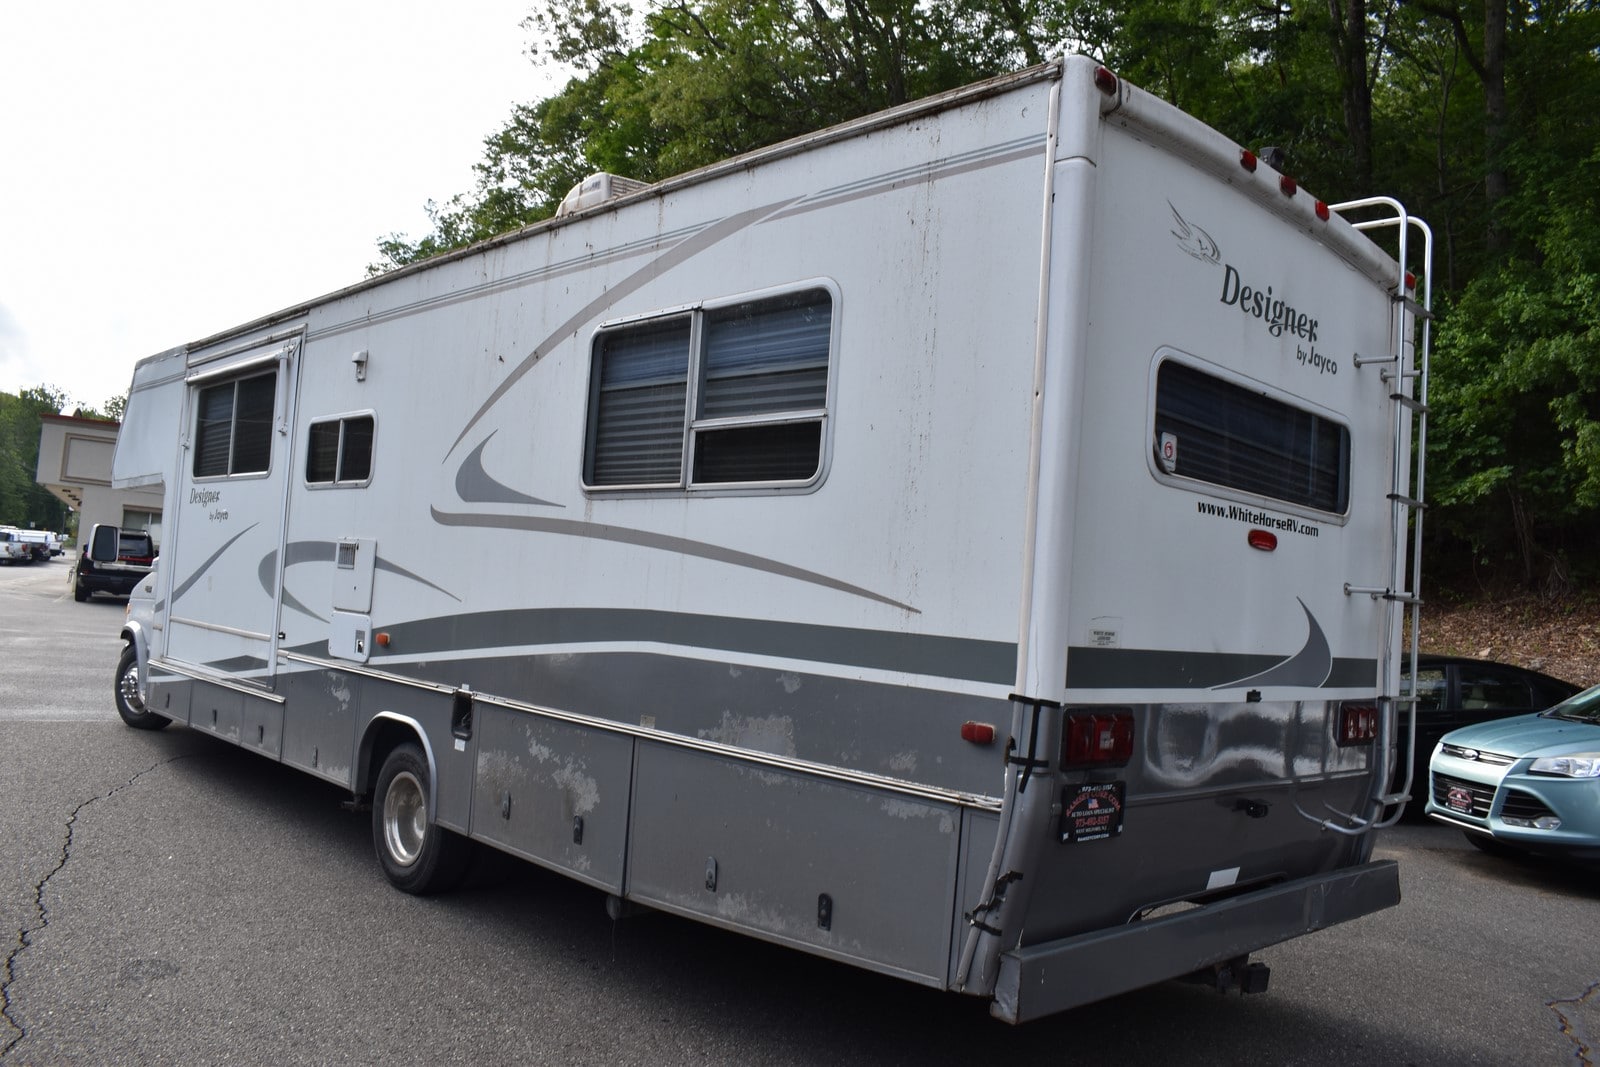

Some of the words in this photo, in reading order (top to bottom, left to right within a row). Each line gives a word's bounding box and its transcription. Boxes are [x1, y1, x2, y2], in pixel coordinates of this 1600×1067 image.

[1220, 264, 1318, 342] Designer
[1296, 344, 1307, 365] by
[1308, 346, 1338, 375] Jayco
[189, 487, 220, 508] Designer
[1197, 501, 1319, 537] www.WhiteHorseRV.com
